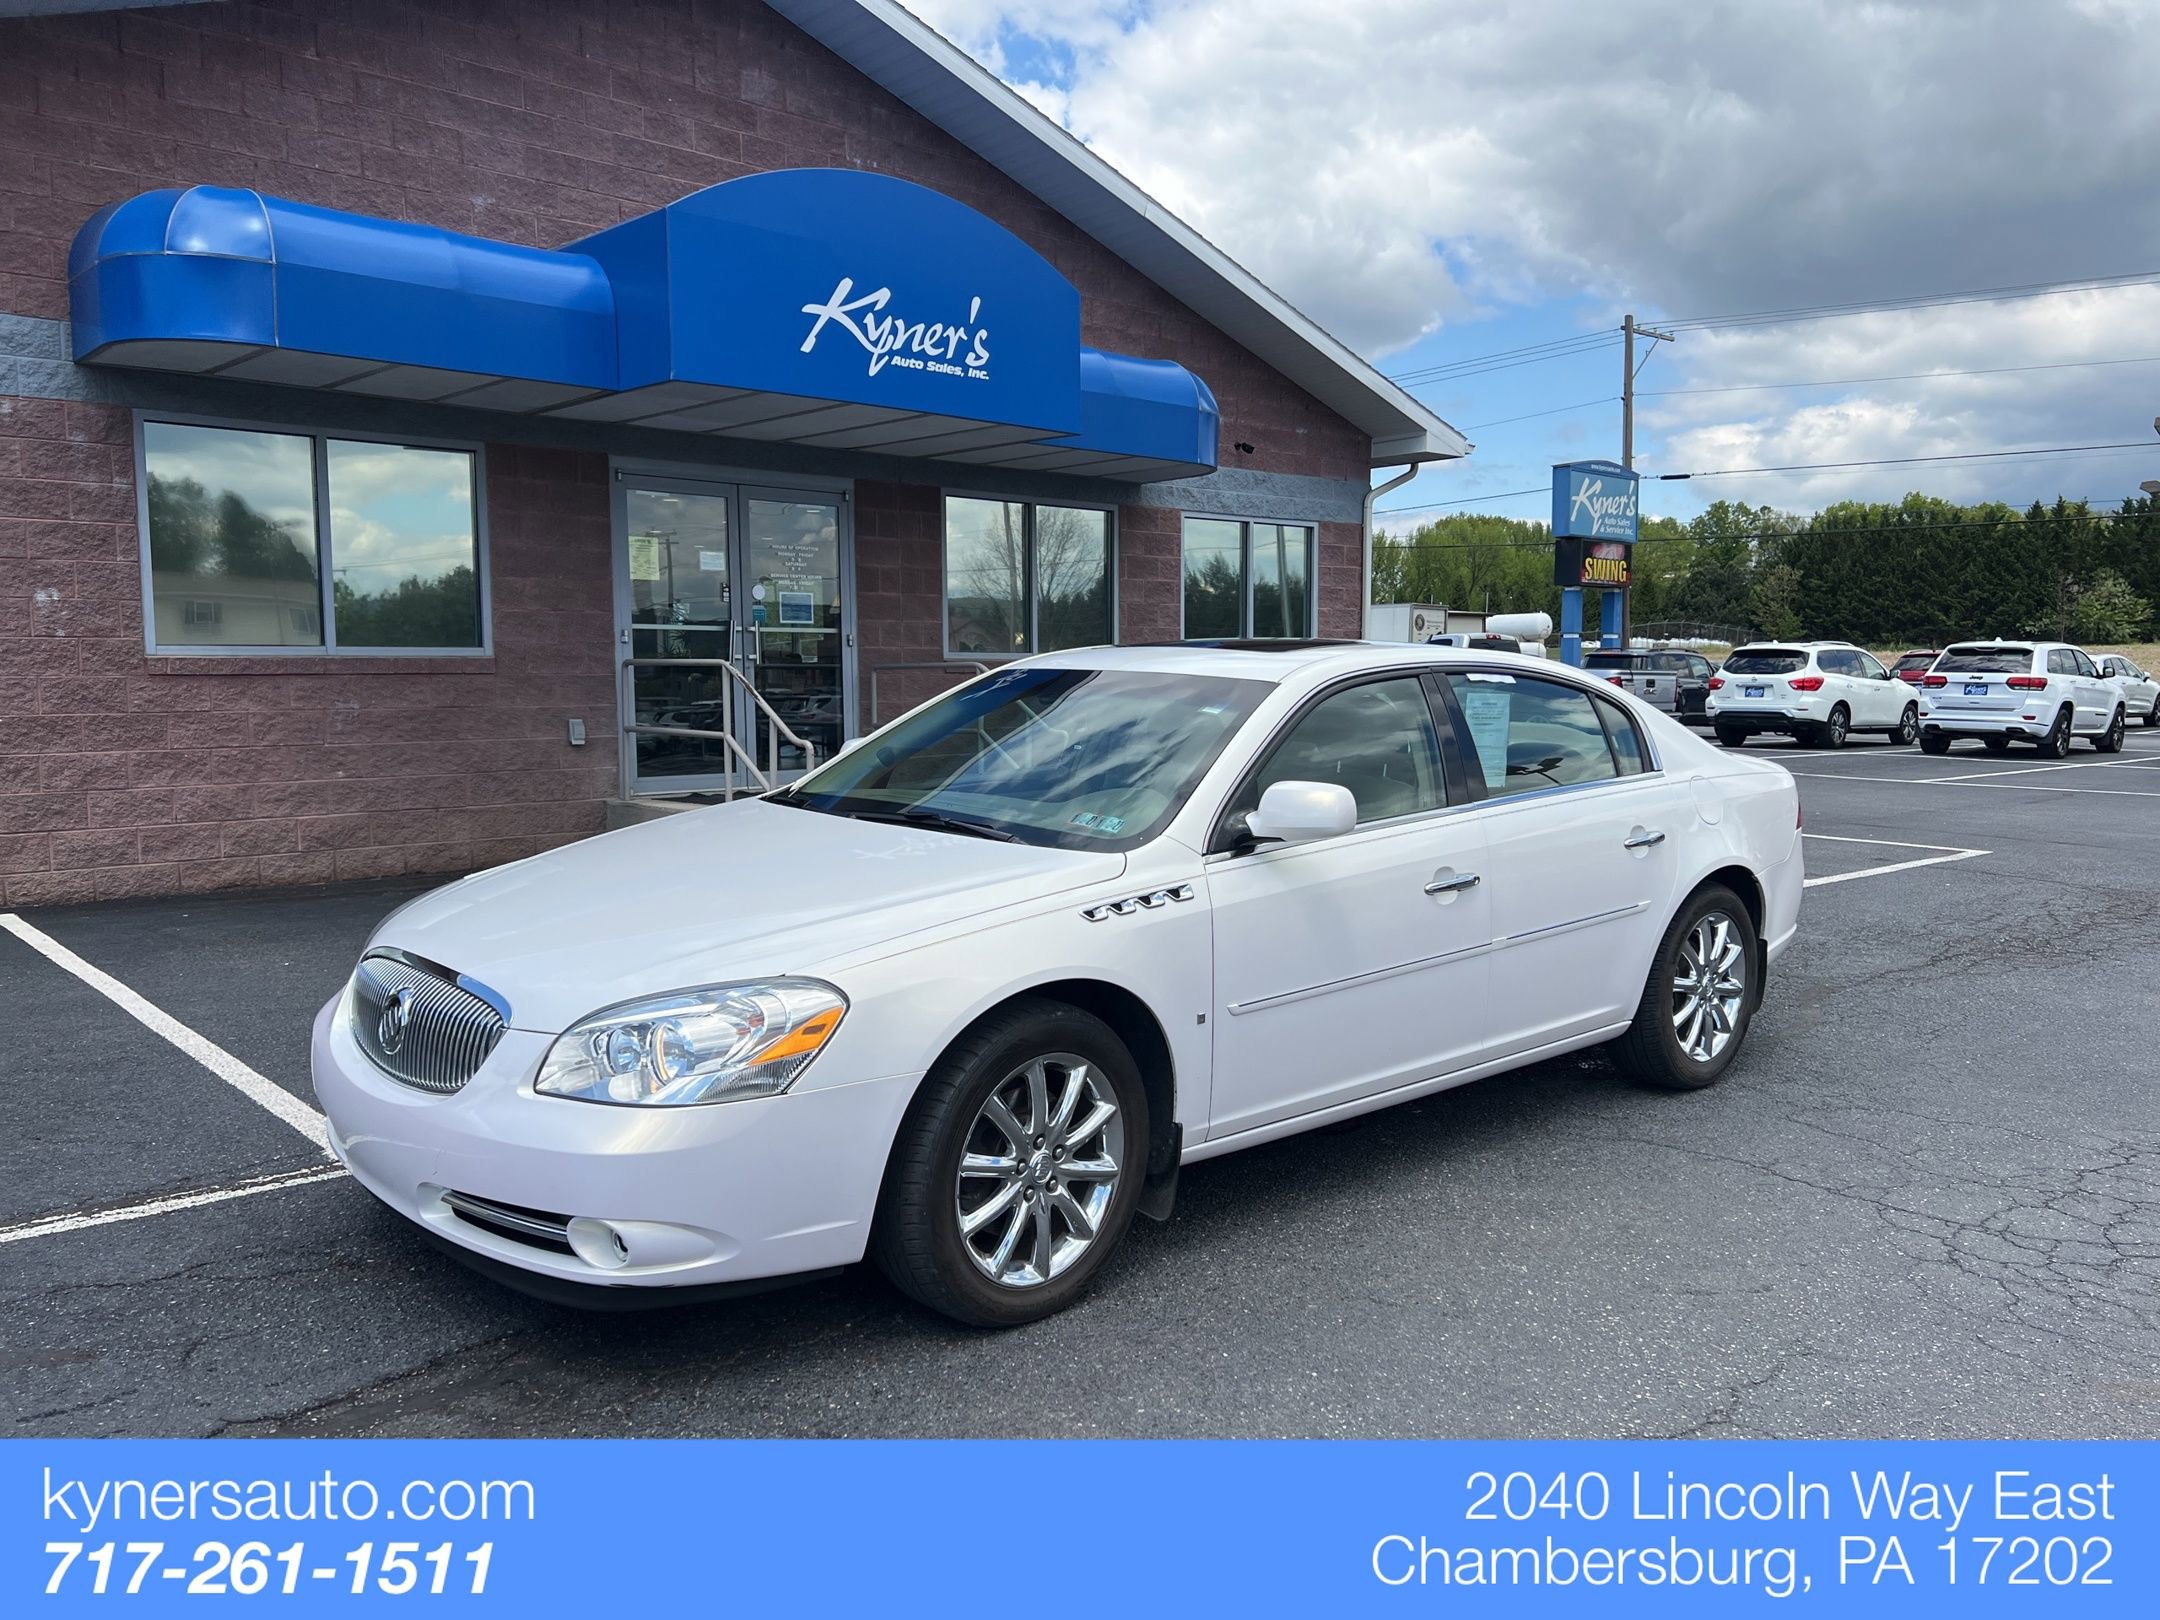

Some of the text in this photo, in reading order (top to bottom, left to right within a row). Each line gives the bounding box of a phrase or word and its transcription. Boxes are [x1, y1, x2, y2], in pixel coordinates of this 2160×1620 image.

[800, 277, 990, 377] Kyner's
[891, 355, 990, 380] Auto Sales, Inc.
[1570, 477, 1636, 535] Kyner's
[1604, 516, 1631, 526] Auto Sales
[1606, 526, 1624, 535] Service
[1585, 557, 1627, 582] SWING
